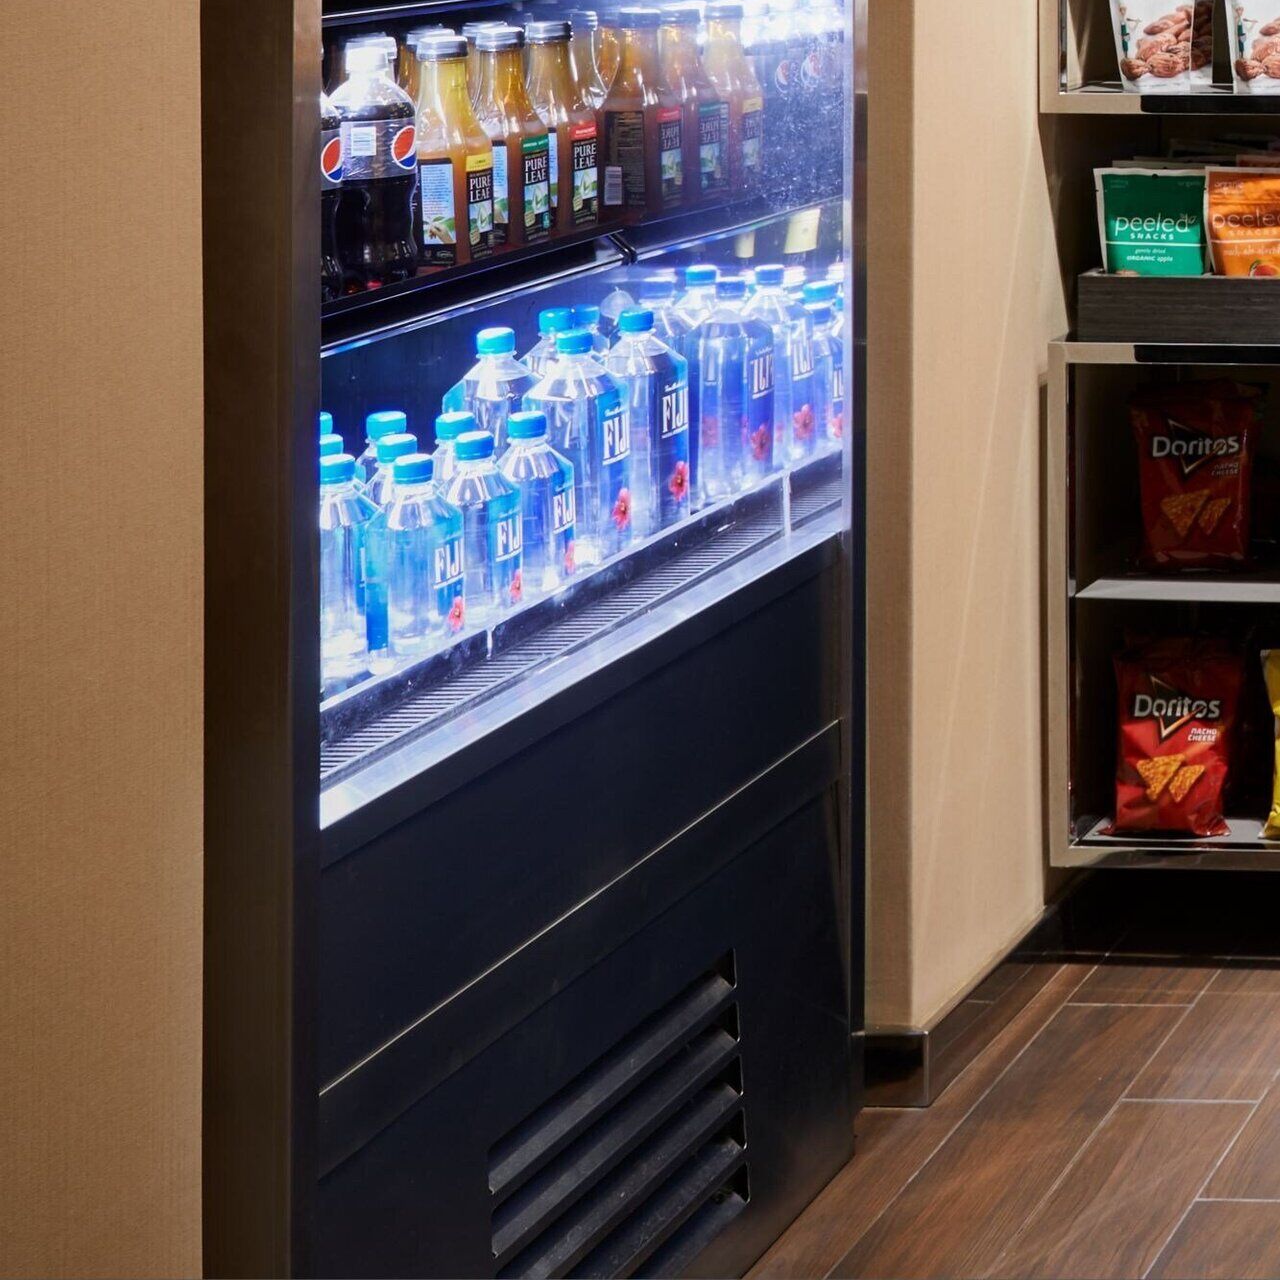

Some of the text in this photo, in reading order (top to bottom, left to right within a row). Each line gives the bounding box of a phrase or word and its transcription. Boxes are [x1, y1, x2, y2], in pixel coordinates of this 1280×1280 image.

[574, 143, 597, 158] PURE
[525, 155, 548, 172] PURE
[574, 155, 596, 170] LEAF
[469, 174, 491, 190] PURE
[525, 168, 547, 184] LEAF
[470, 186, 490, 202] LEAF
[1115, 213, 1190, 236] peeled
[1129, 232, 1175, 240] SNACKS
[1157, 255, 1174, 263] apple
[662, 387, 689, 434] FIJI
[602, 412, 630, 459] FIJI
[1152, 436, 1240, 458] Doritos
[552, 487, 577, 531] FIJI
[496, 513, 523, 558] FIJI
[435, 537, 465, 586] FIJI
[1134, 694, 1221, 719] Doritos
[1188, 734, 1217, 742] CHEESE
[1191, 727, 1217, 735] NACHO
